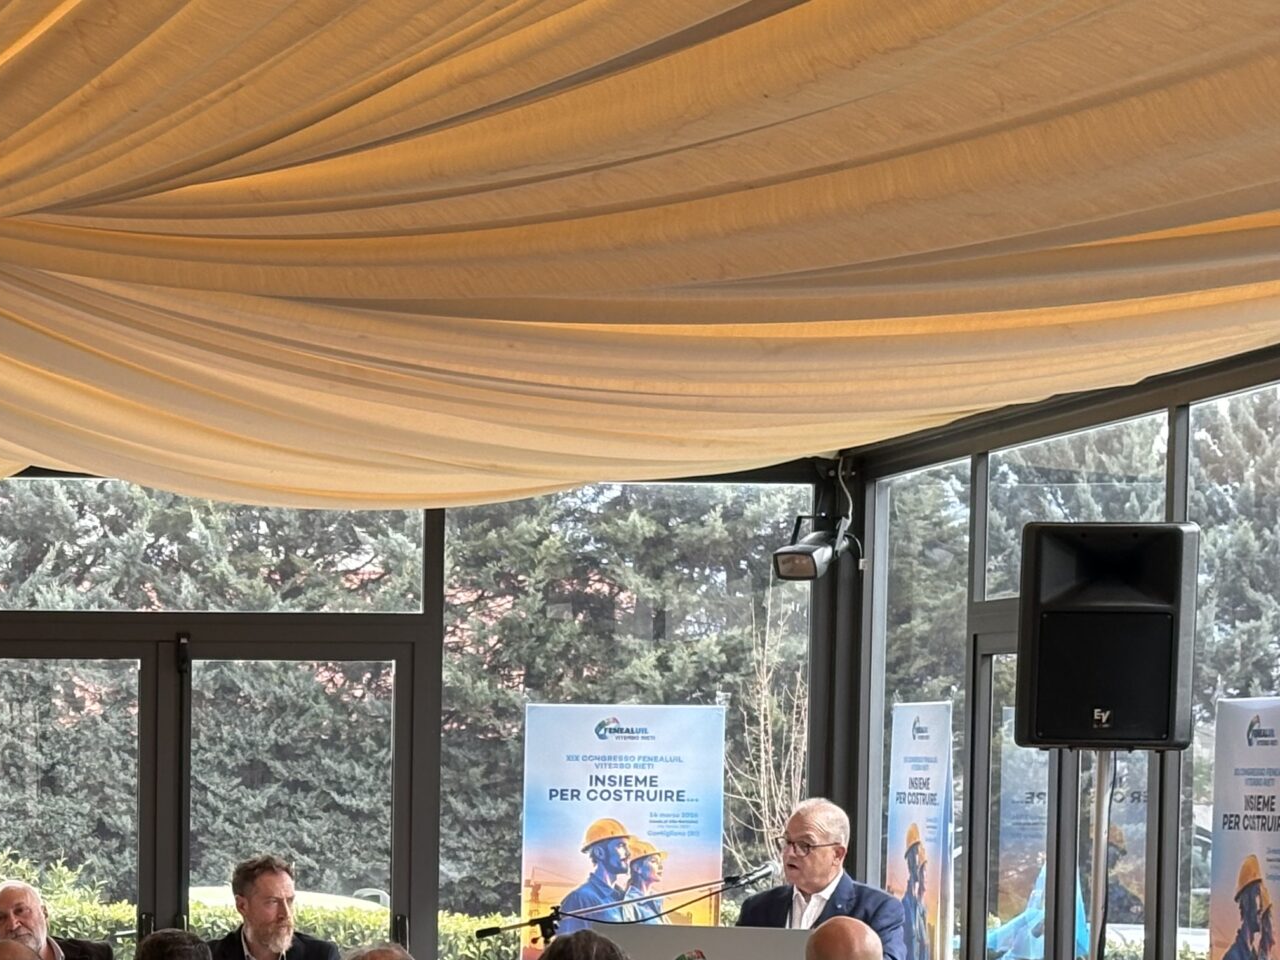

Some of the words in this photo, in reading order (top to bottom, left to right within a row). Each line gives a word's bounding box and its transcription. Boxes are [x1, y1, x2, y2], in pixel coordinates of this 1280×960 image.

[604, 727, 649, 735] FENEALUIL
[581, 755, 636, 763] CONGRESSO
[637, 755, 684, 763] FENEALUIL
[589, 774, 659, 787] INSIEME
[908, 777, 930, 790] INSIEME
[548, 788, 581, 801] PER
[896, 791, 906, 804] PER
[1244, 794, 1276, 812] INSIEME
[1222, 813, 1240, 830] PER
